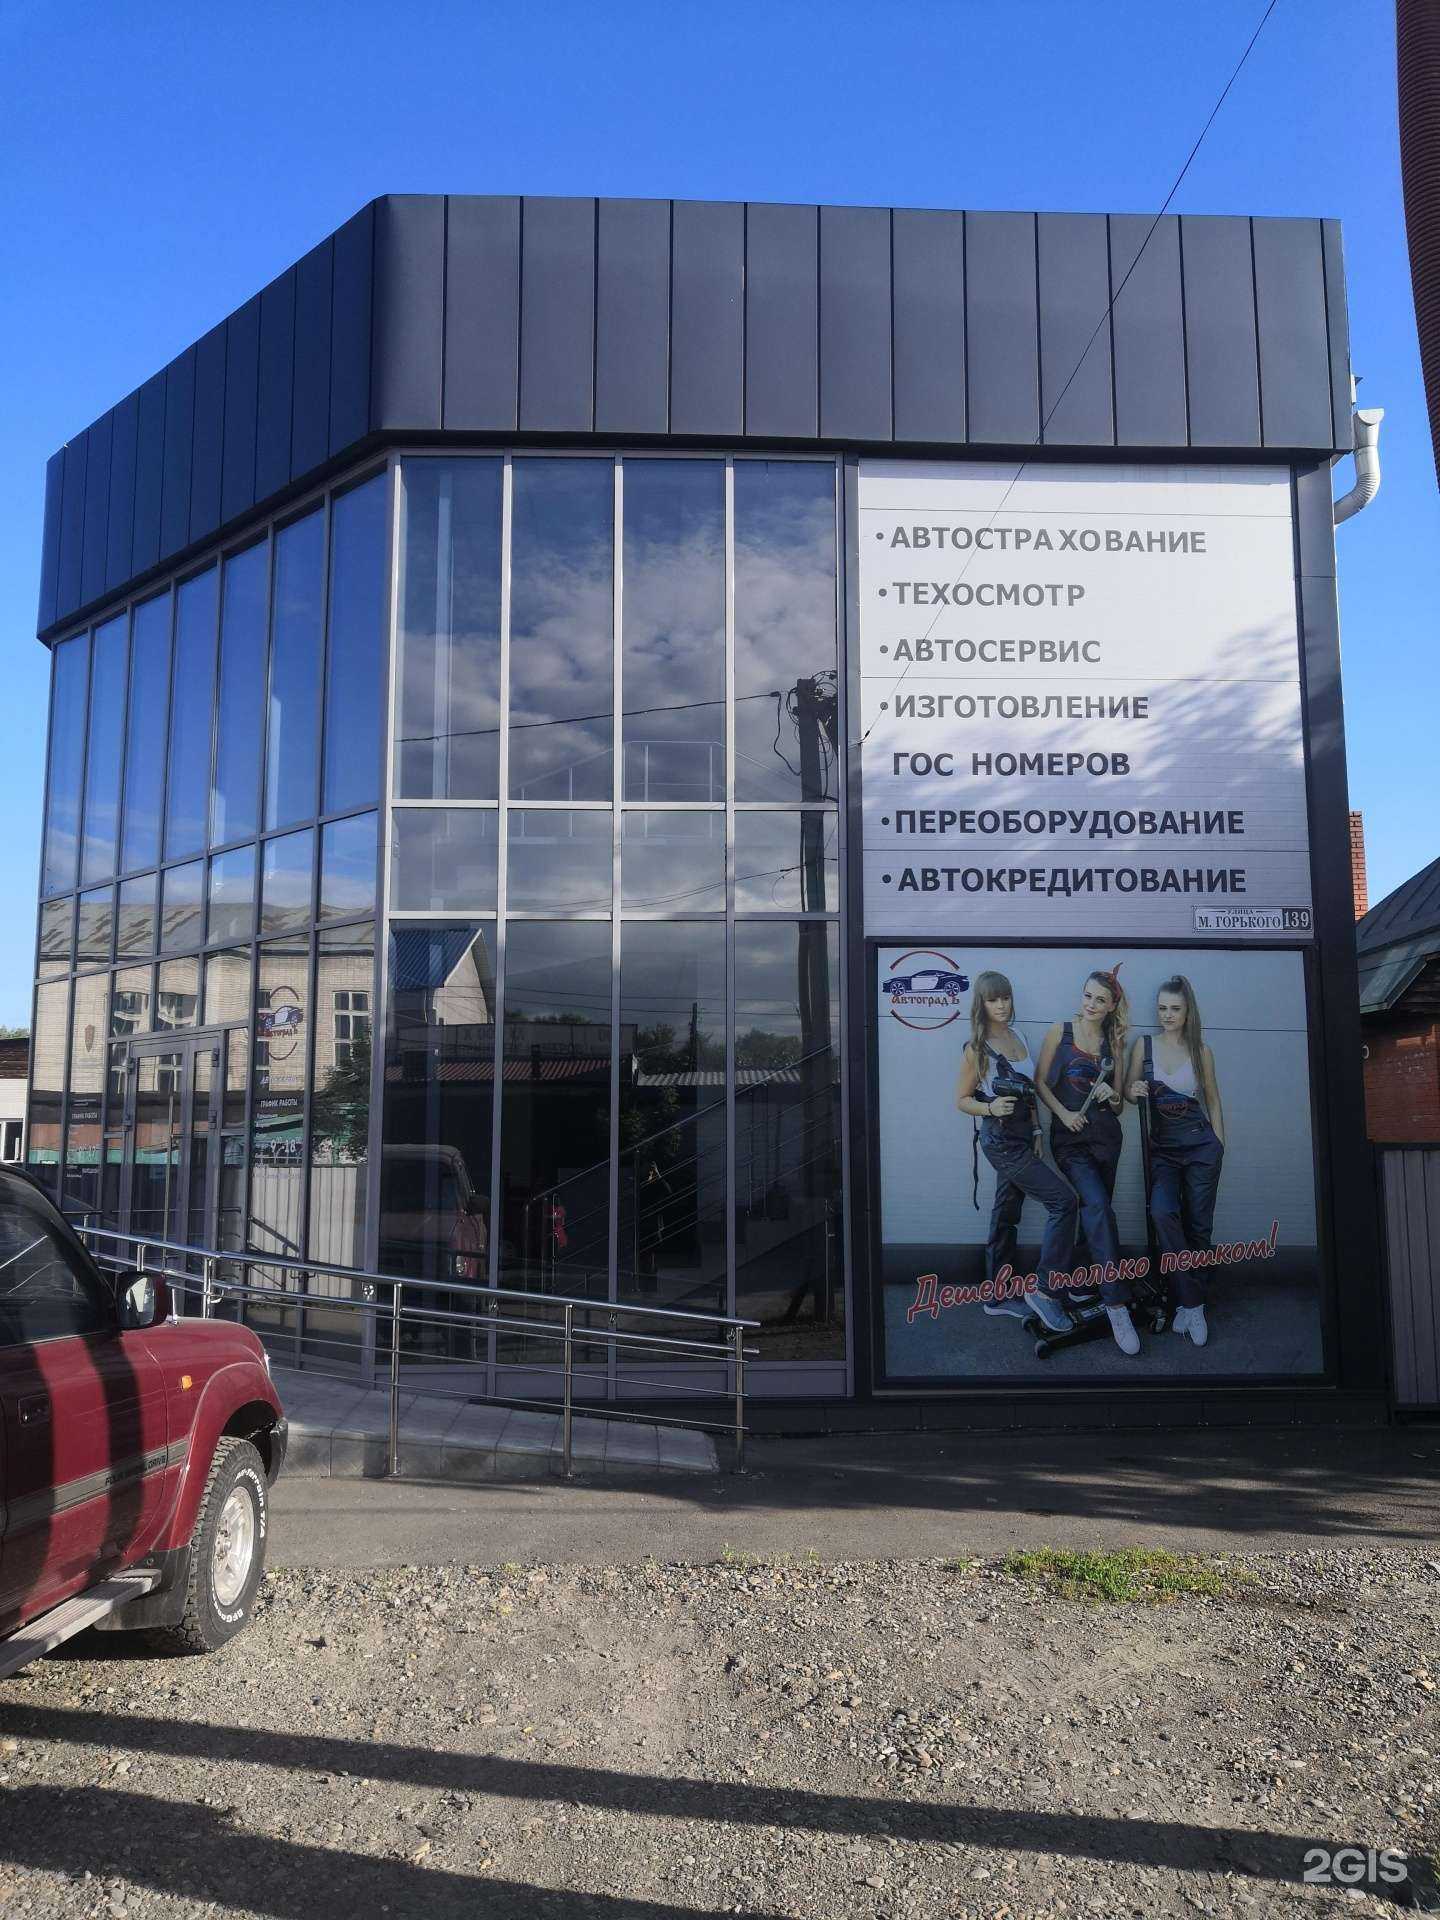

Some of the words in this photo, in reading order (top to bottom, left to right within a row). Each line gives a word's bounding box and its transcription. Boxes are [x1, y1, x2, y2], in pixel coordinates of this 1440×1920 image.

[890, 526, 1207, 553] АВТОСТРАХОВАНИЕ
[892, 582, 1085, 607] ТЕХОСМОТР
[893, 639, 1101, 663] АВТОСЕРВИС
[895, 695, 1149, 719] ИЗГОТОВЛЕНИЕ
[893, 752, 954, 776] ГОС
[972, 752, 1130, 776] НОМЕРОВ
[896, 809, 1244, 838] ПЕРЕОБОРУДОВАНИЕ
[898, 868, 1246, 897] АВТОКРЕДИТОВАНИЕ
[1198, 916, 1212, 928] М.
[1216, 916, 1281, 928] ГОРЬКОГО
[1284, 911, 1309, 928] 139
[907, 1264, 1039, 1324] Дешевле
[1049, 1256, 1150, 1290] только
[1160, 1218, 1280, 1275] пешком!
